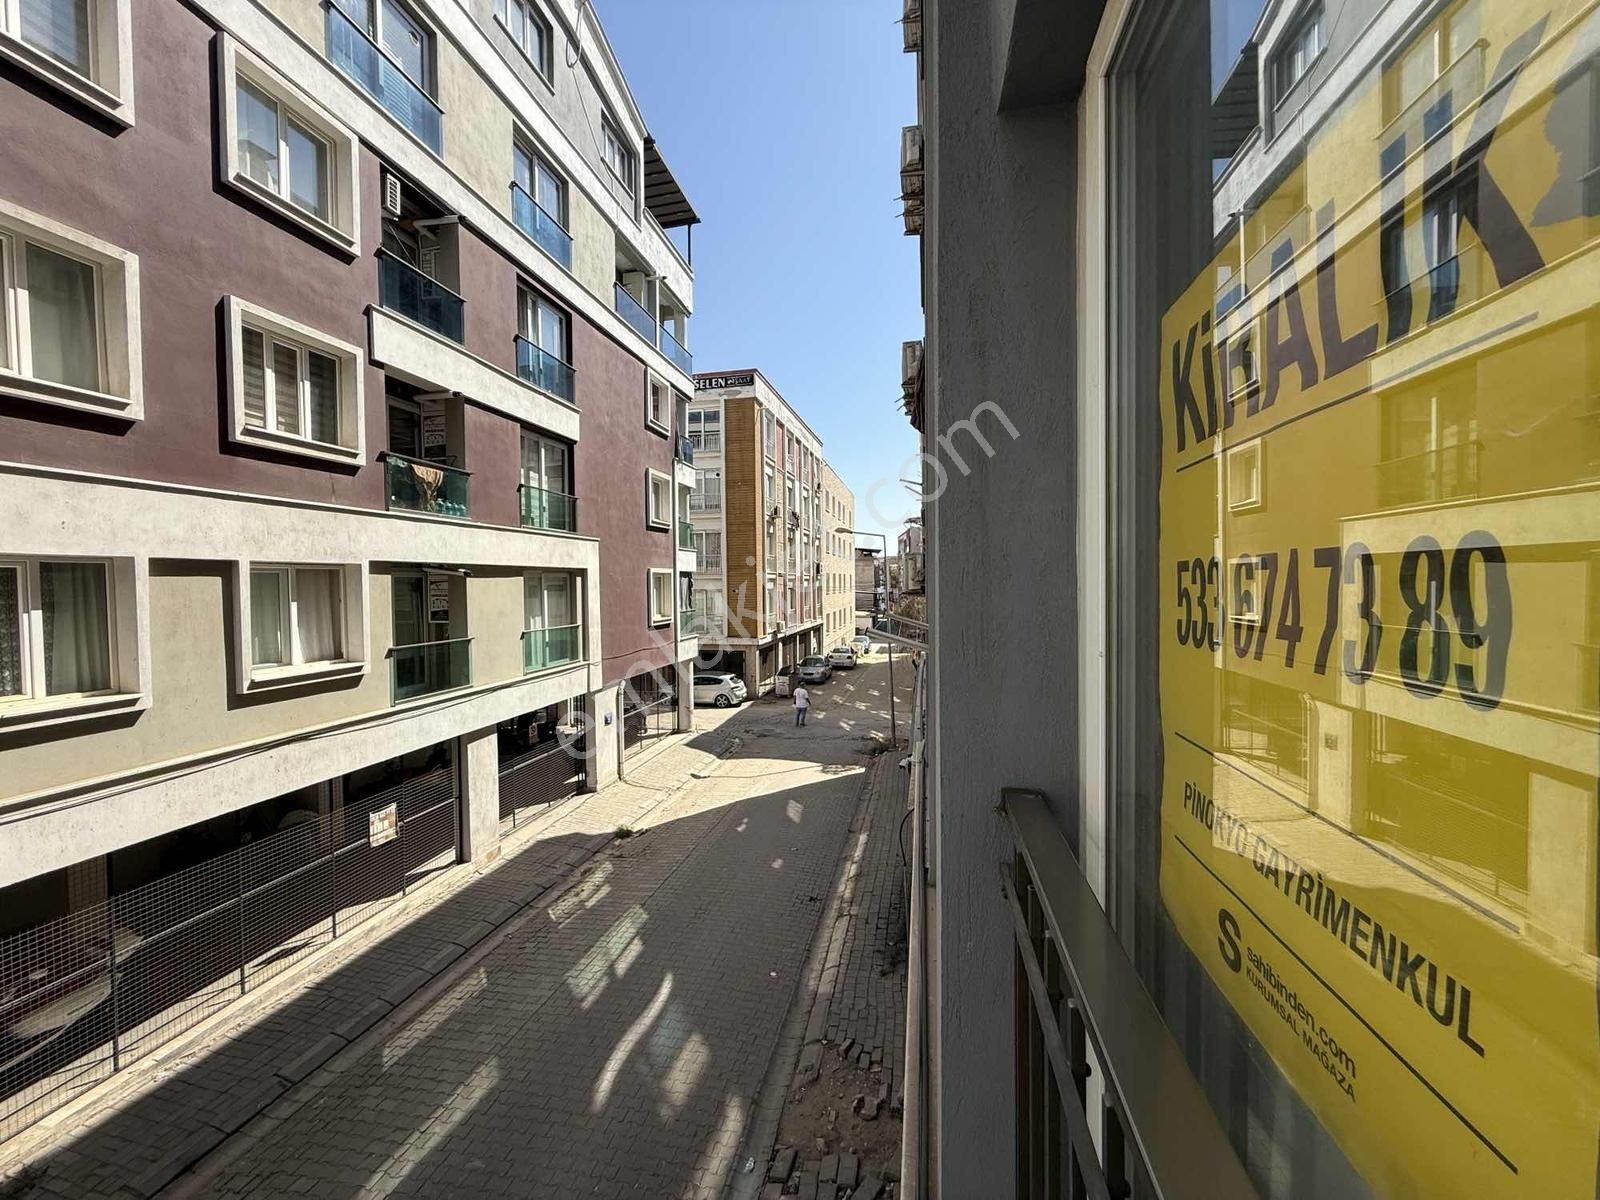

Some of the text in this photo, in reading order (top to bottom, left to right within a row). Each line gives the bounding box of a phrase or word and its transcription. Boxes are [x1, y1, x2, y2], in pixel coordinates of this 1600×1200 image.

[1172, 12, 1550, 453] KİRALIK
[1177, 530, 1512, 711] 533 674 73 89
[1183, 782, 1486, 1057] PİNOKYO GAYRİMENKUL
[1217, 908, 1242, 974] S
[1246, 965, 1300, 1036] KURUMSAL
[1246, 946, 1356, 1079] sahibinden.com
